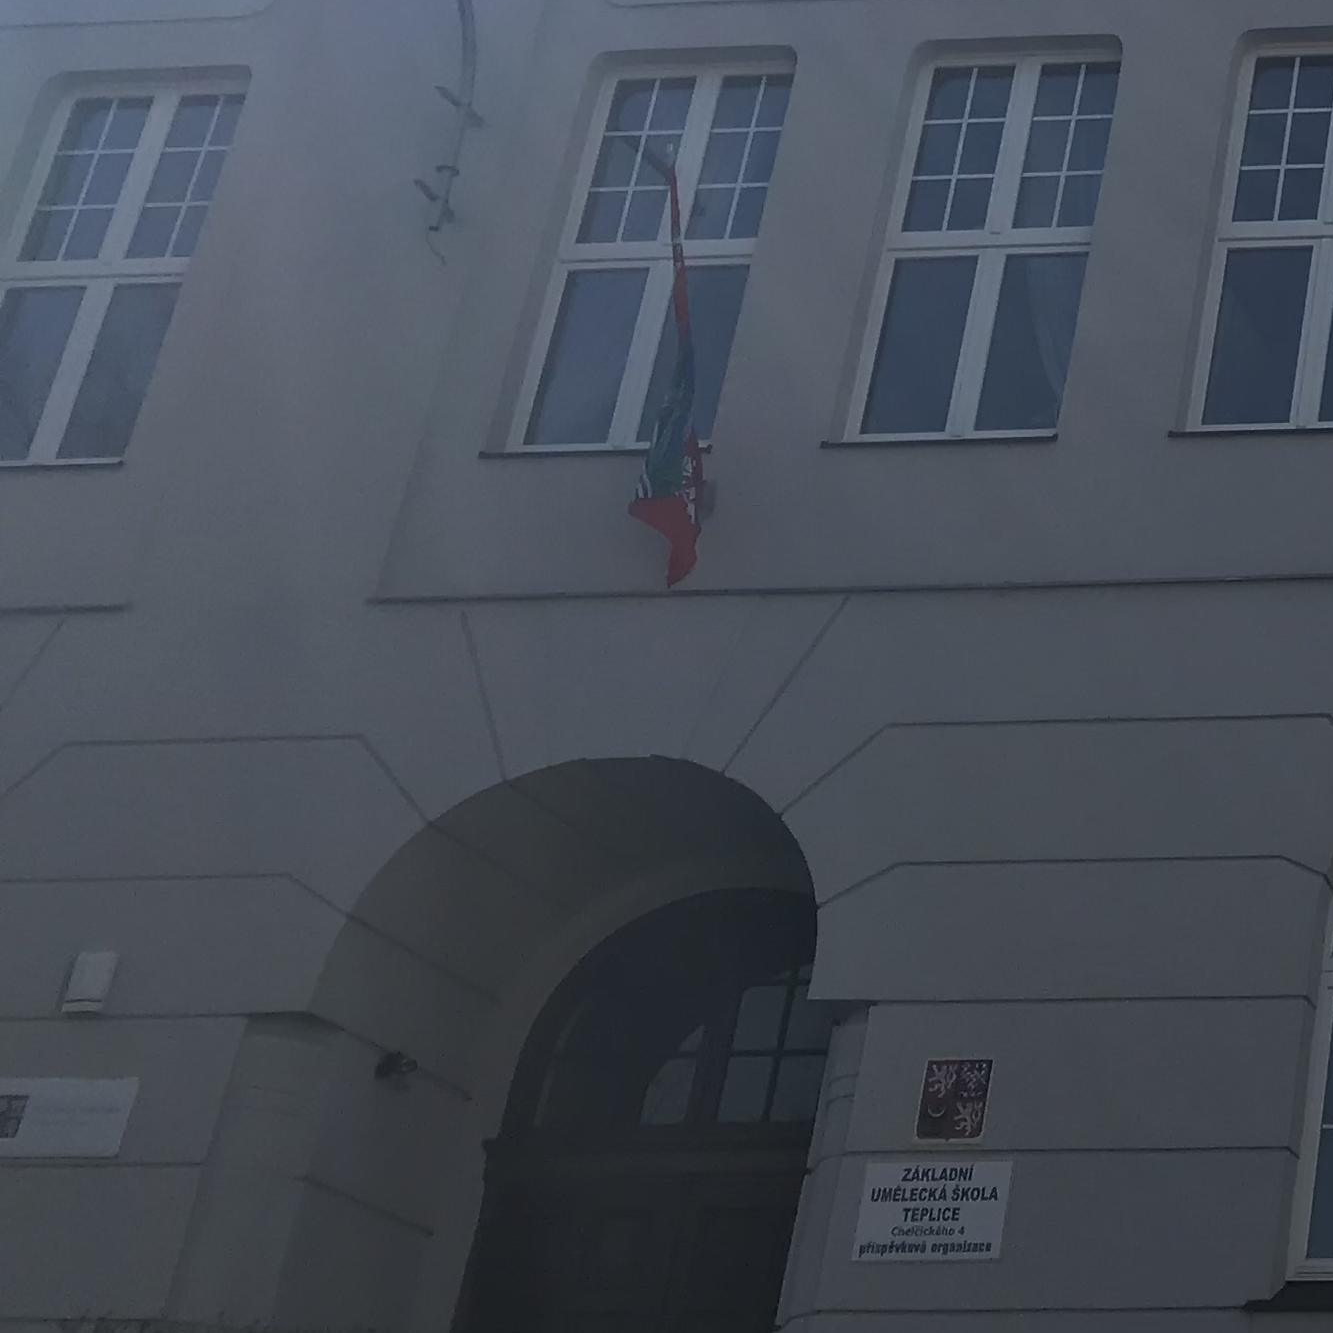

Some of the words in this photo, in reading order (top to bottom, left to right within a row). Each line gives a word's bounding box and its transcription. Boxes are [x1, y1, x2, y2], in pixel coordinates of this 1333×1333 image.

[901, 1164, 975, 1182] ZÁKLADNÍ
[870, 1184, 947, 1202] UMĚLECKÁ
[951, 1185, 998, 1202] ŠKOLA
[902, 1207, 960, 1222] TEPLICE
[957, 1226, 965, 1236] 4
